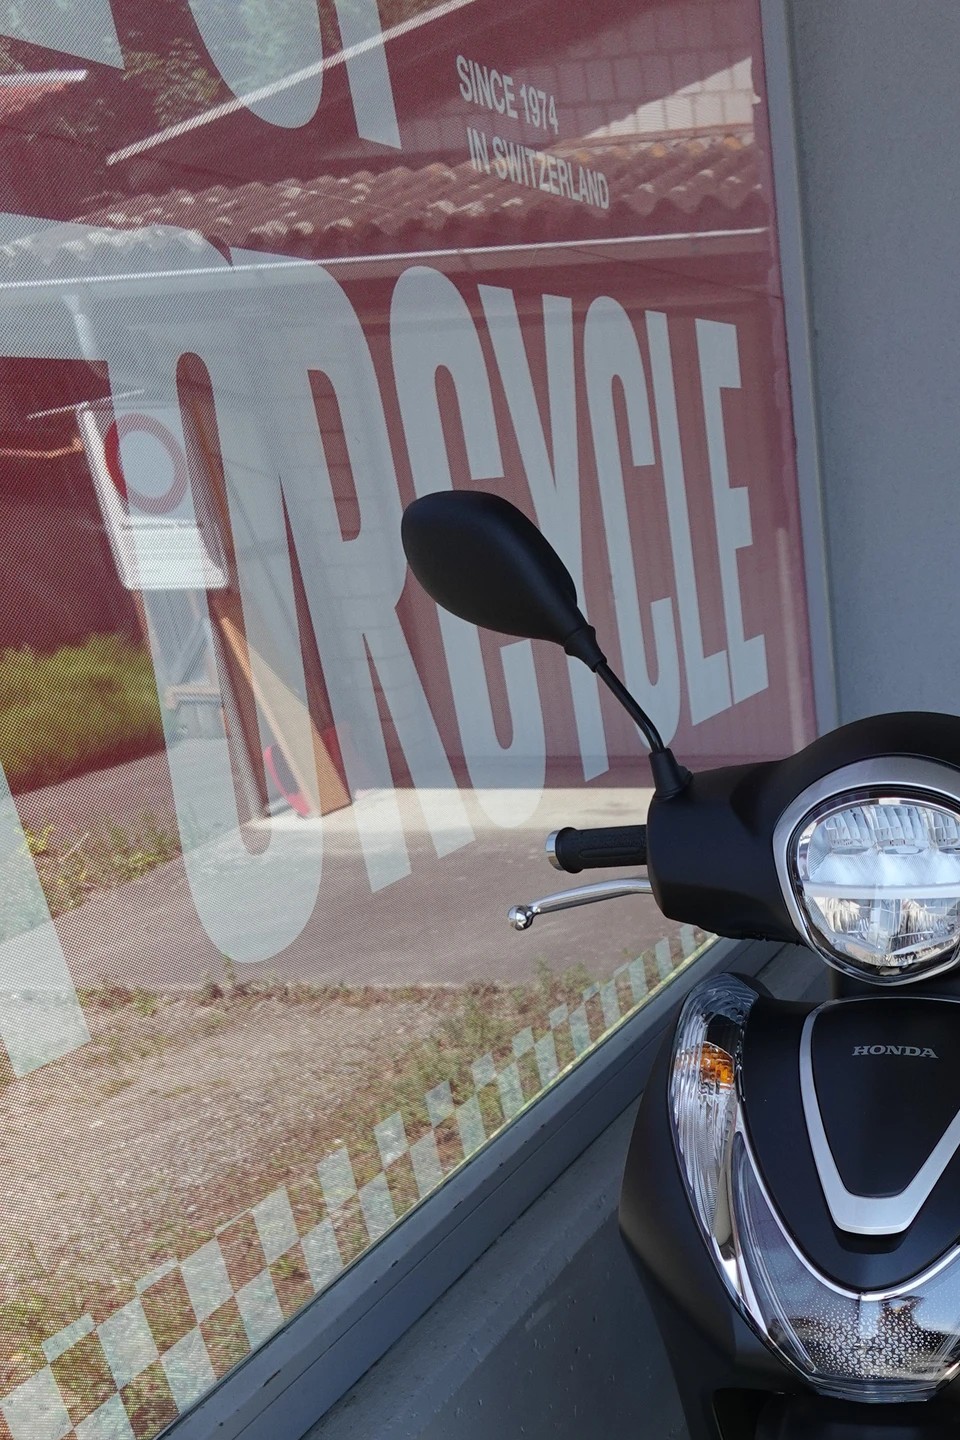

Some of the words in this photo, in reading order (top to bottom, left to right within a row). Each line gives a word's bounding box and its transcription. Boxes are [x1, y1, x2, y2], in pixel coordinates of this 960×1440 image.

[456, 55, 519, 119] SINCE
[520, 84, 559, 135] 1974
[467, 127, 491, 175] IN
[492, 136, 610, 210] SWITZERLAND
[852, 1045, 939, 1059] HONDA
